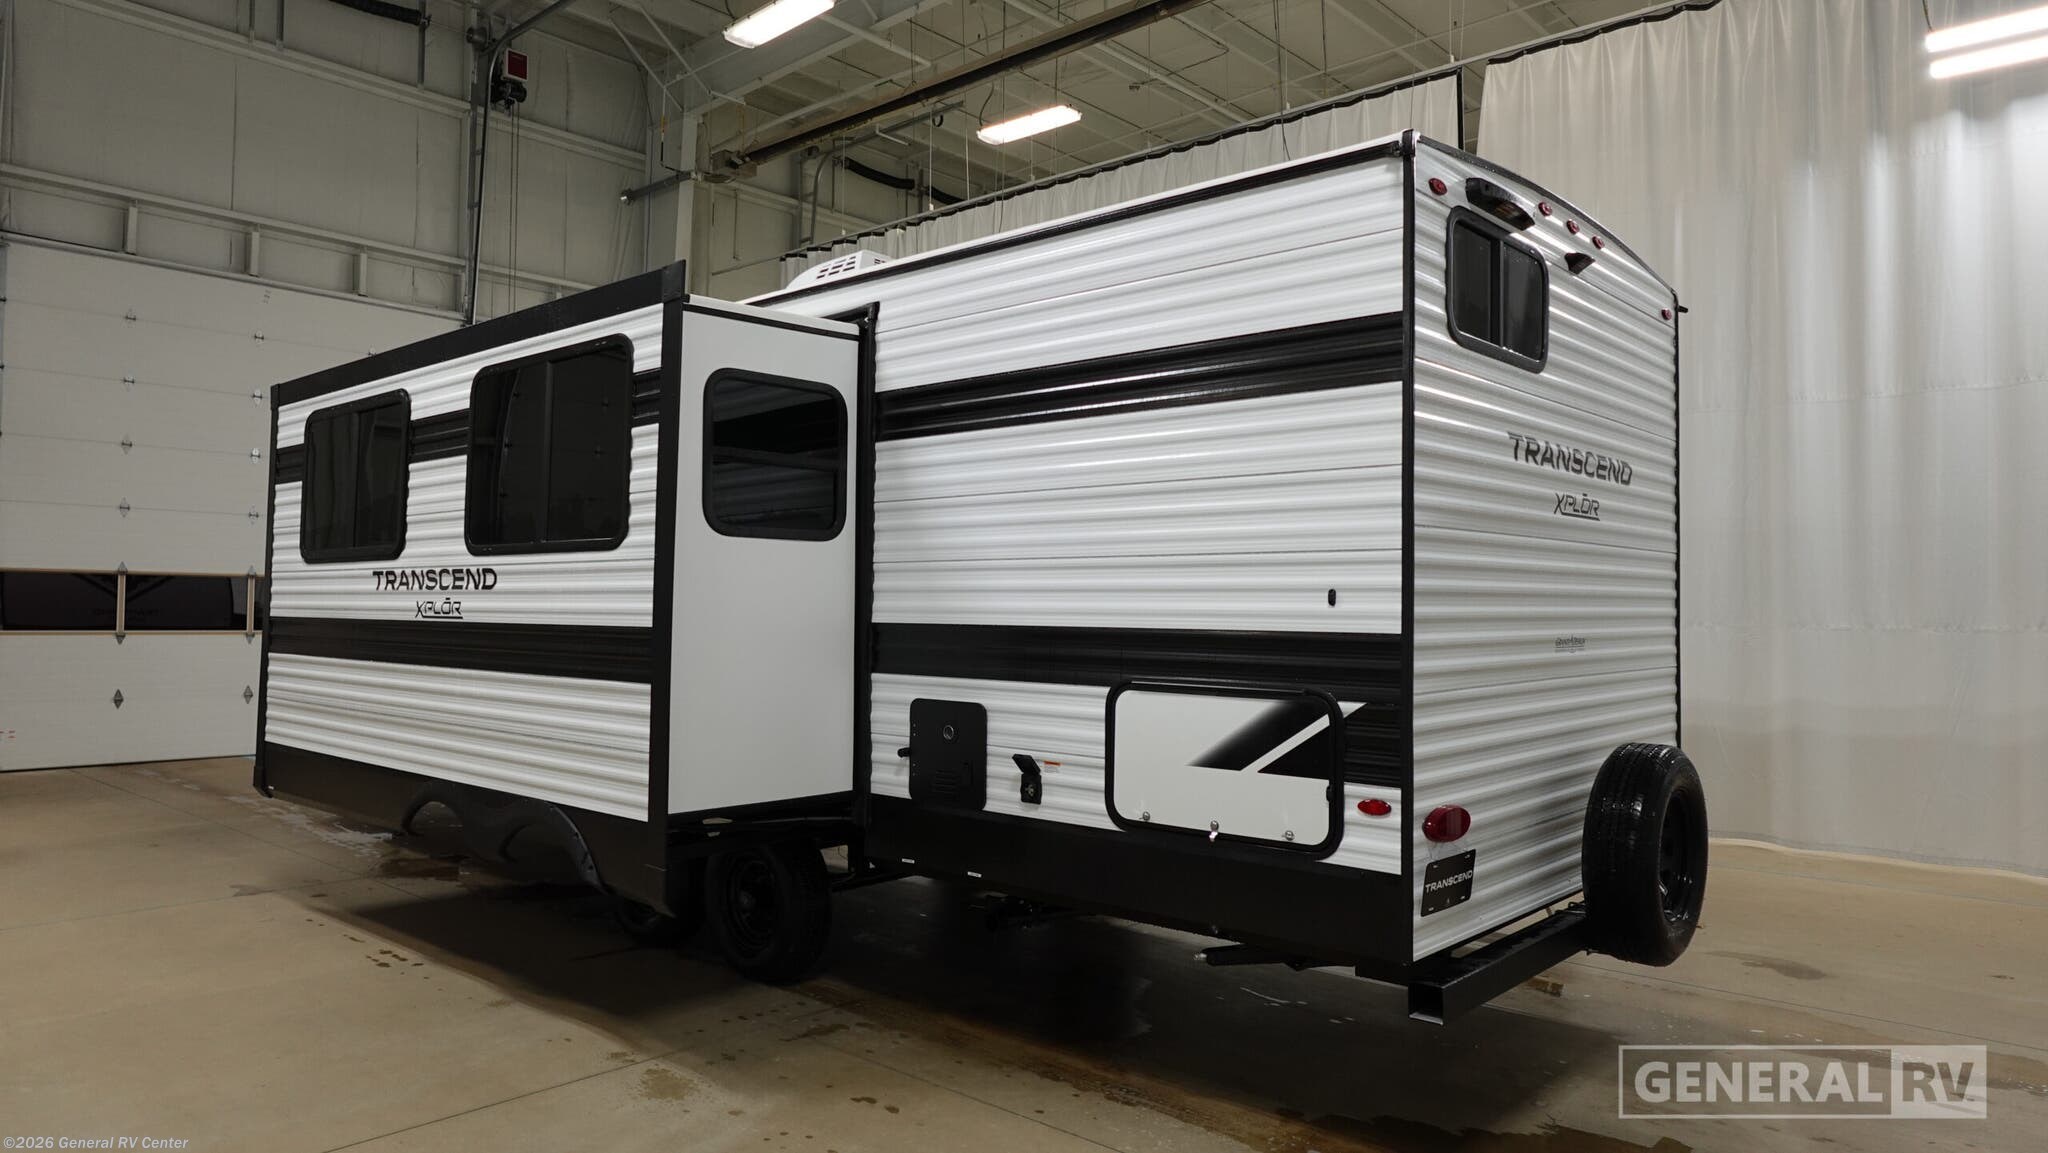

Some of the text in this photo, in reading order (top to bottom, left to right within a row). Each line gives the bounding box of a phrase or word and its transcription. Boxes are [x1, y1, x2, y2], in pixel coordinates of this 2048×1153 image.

[1507, 431, 1632, 485] TRANSCEND
[372, 568, 498, 591] TRANSCEND
[1425, 870, 1473, 893] TRANSCEND
